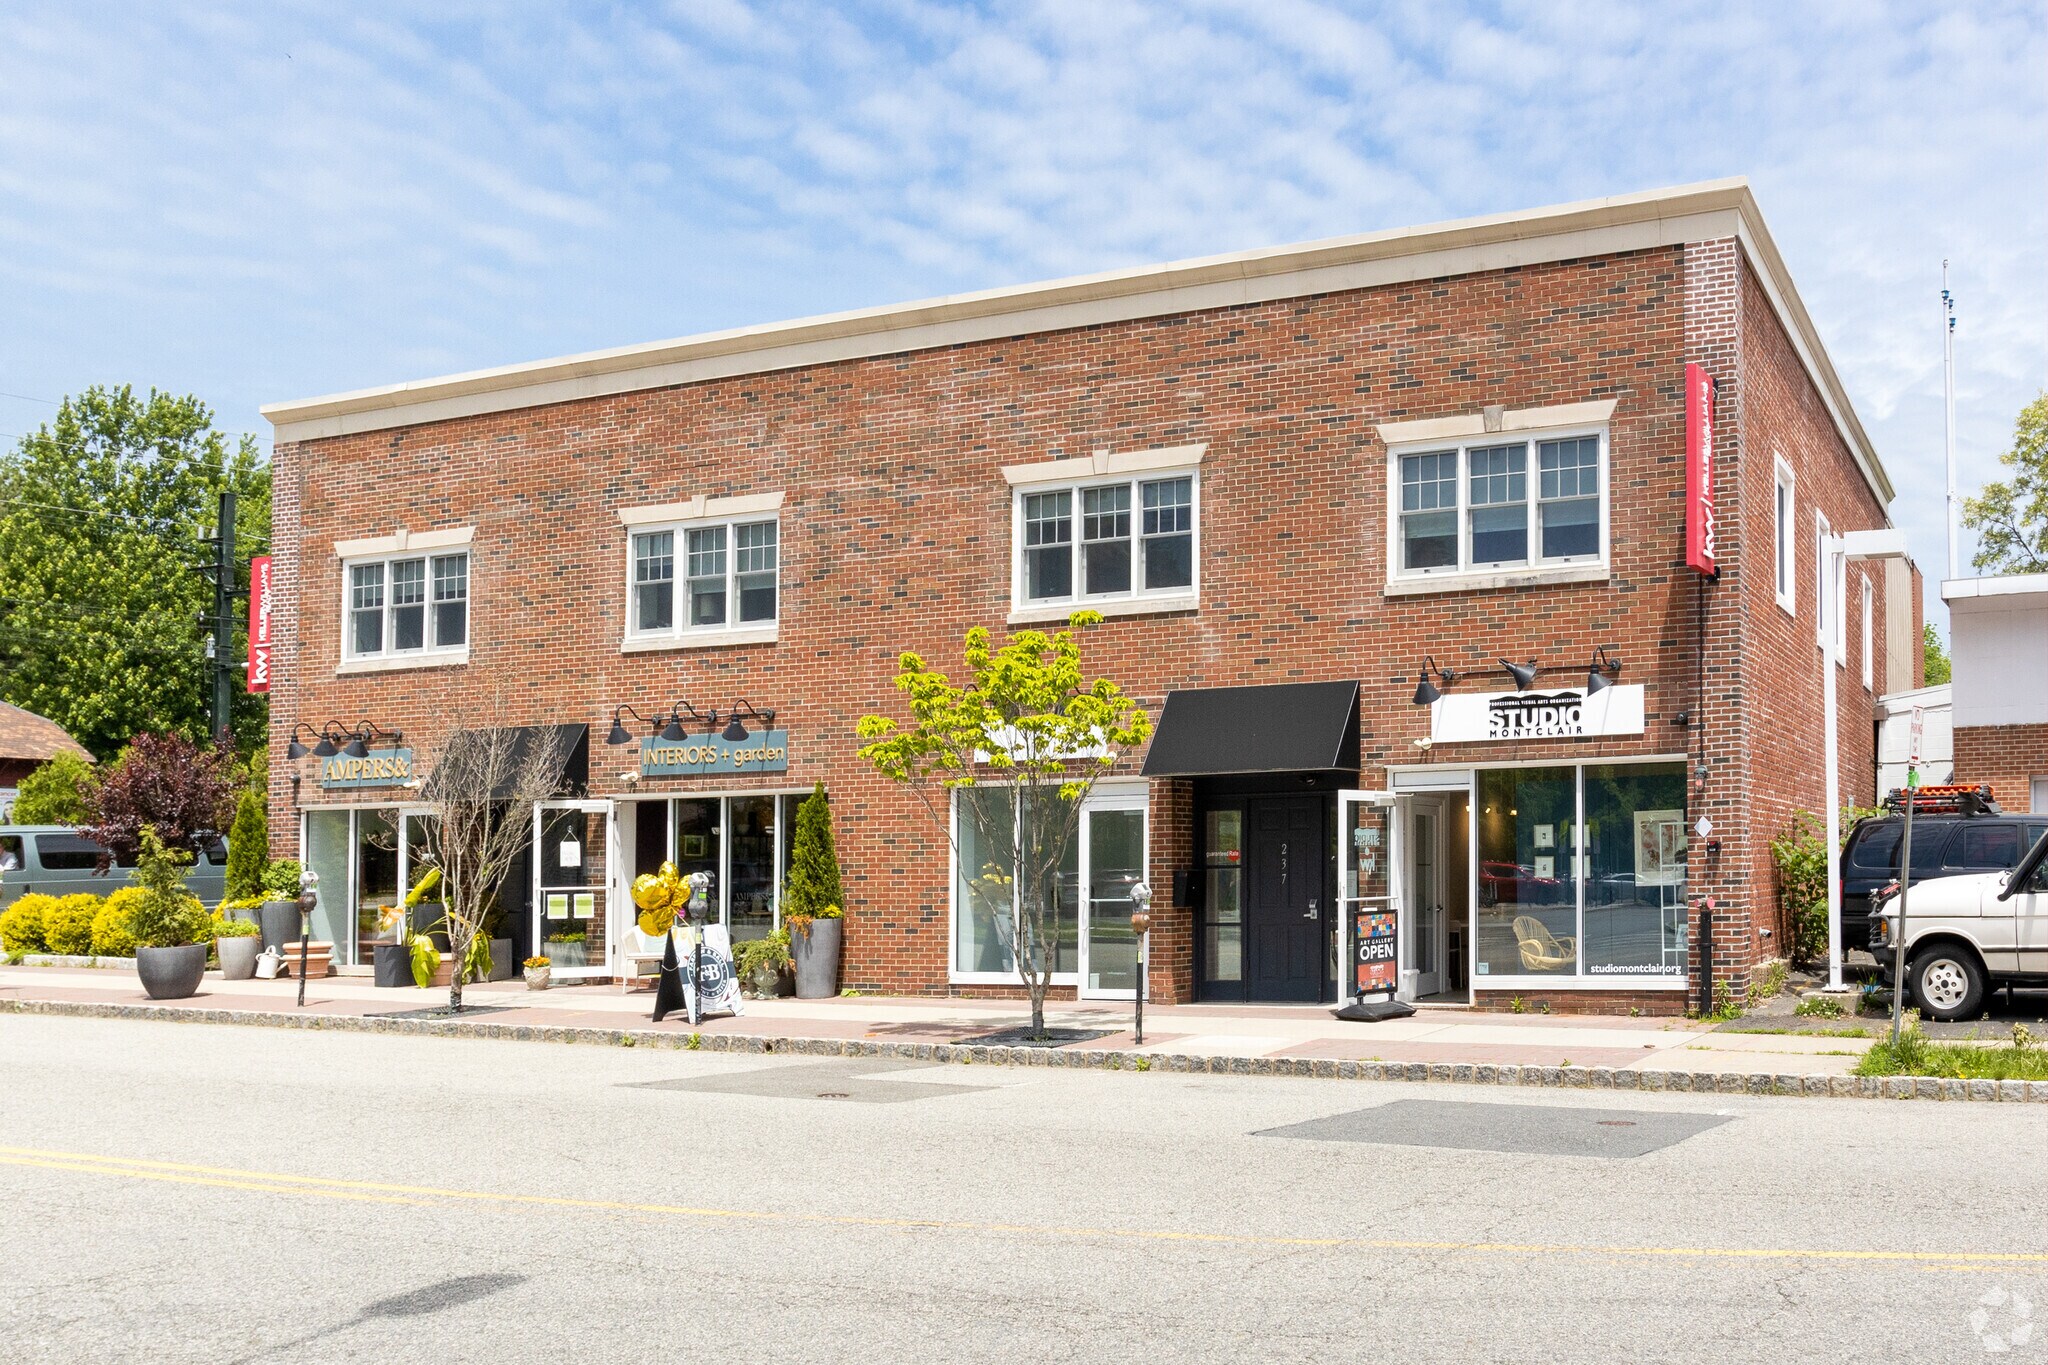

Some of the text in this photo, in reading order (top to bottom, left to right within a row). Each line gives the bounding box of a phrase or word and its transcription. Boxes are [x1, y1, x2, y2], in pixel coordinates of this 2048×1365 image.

[1702, 507, 1714, 559] kw
[251, 649, 268, 684] kw
[1489, 706, 1582, 728] STUDIO
[1490, 726, 1582, 738] MONTCLAIR
[643, 745, 718, 766] INTERIORS
[734, 743, 784, 767] garden
[323, 756, 410, 781] AMPERS&
[1360, 943, 1394, 961] OPEN
[1371, 937, 1394, 945] GALLERY
[1590, 963, 1682, 975] studiomontclair.org
